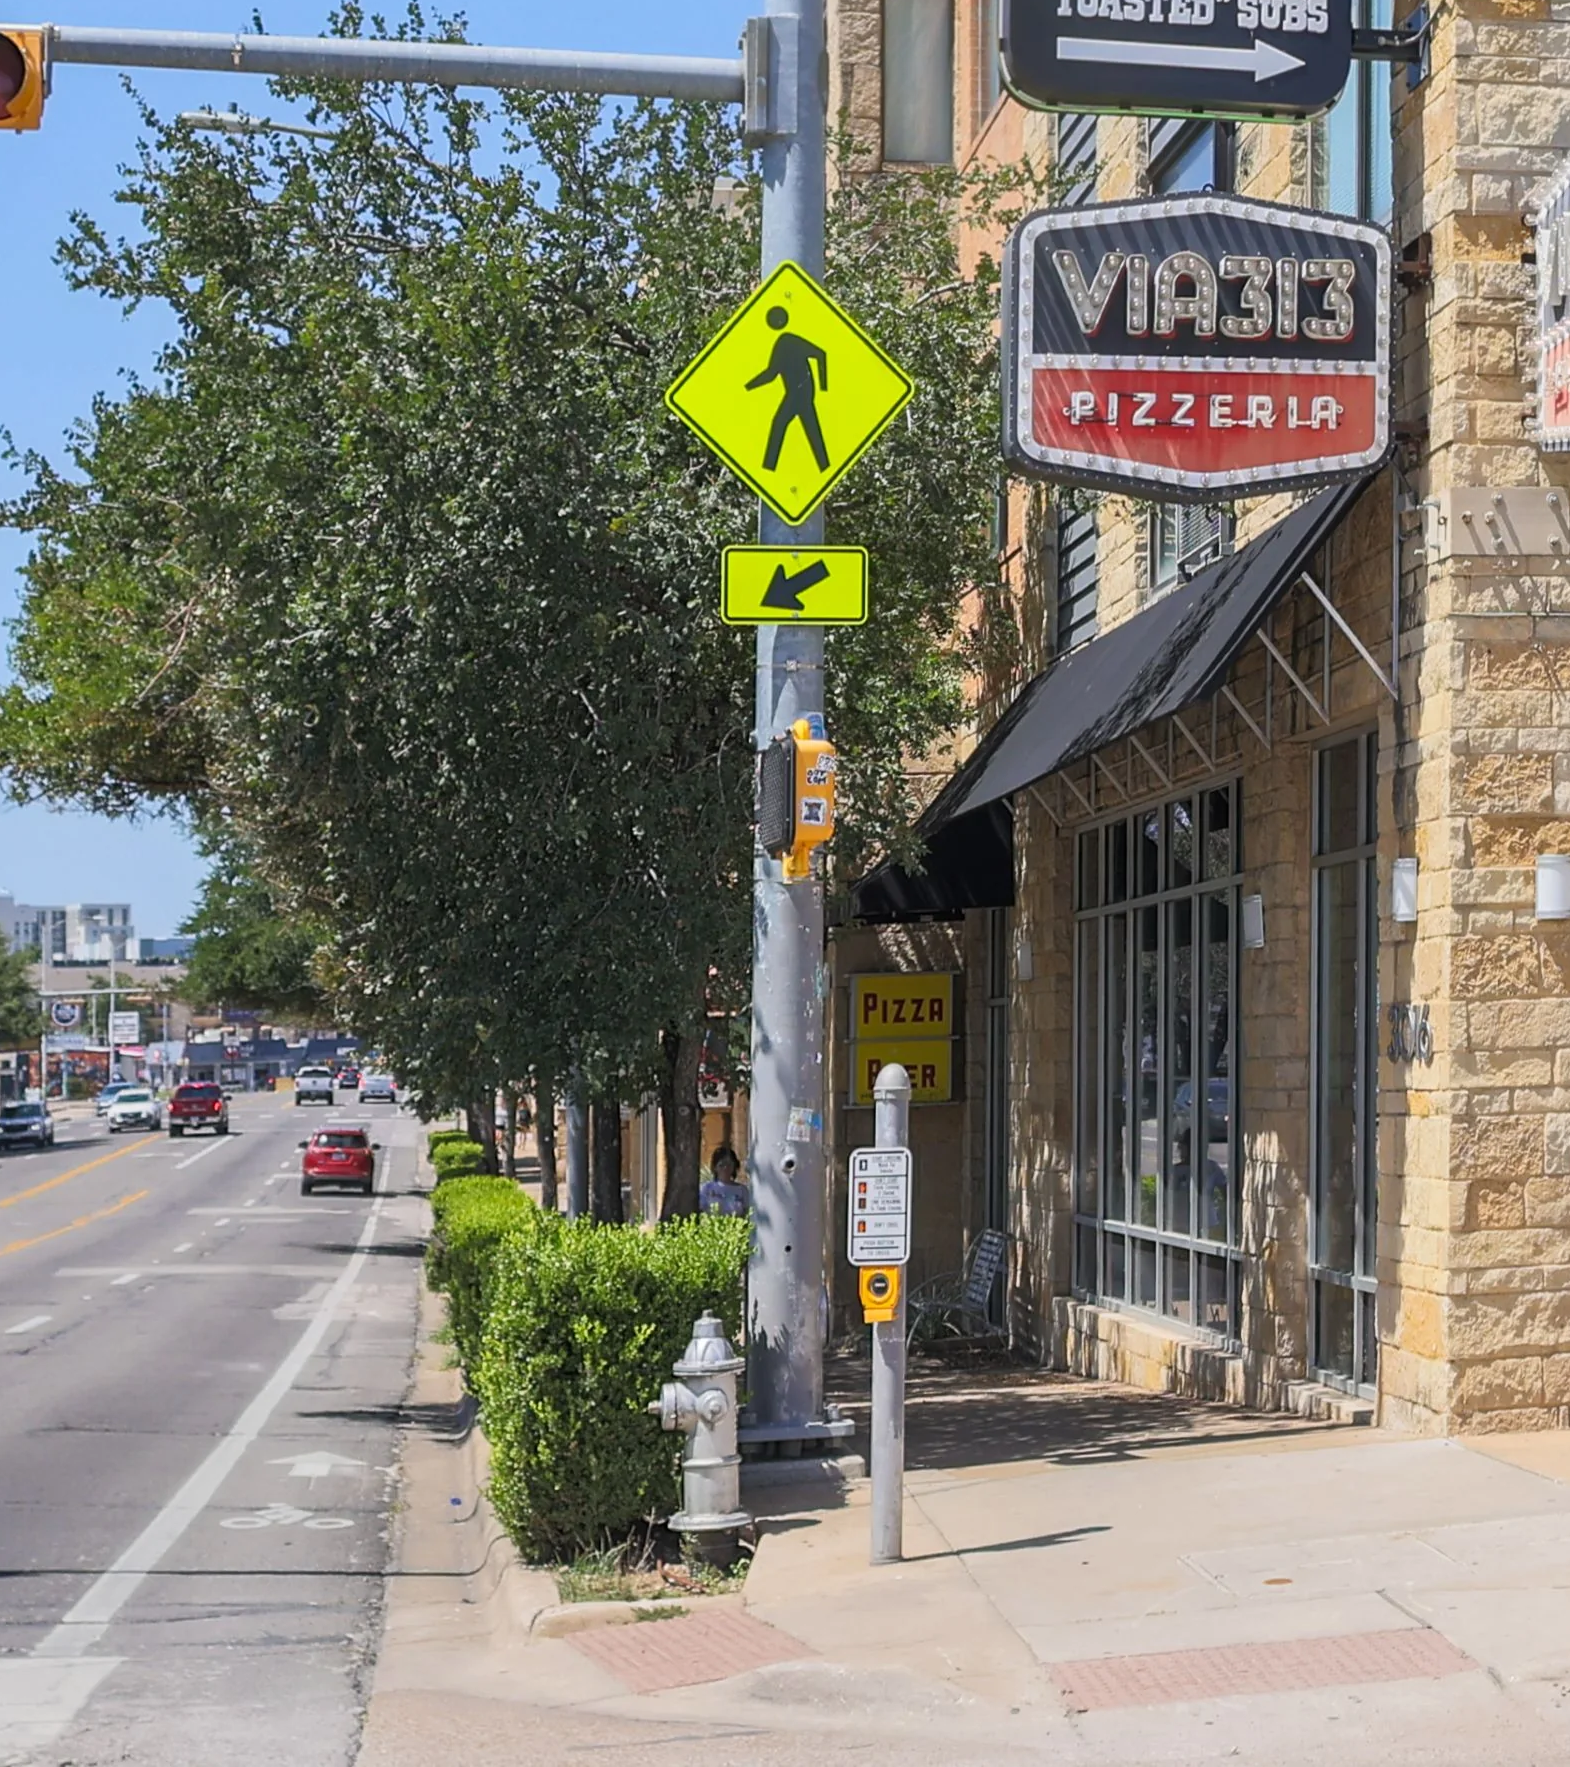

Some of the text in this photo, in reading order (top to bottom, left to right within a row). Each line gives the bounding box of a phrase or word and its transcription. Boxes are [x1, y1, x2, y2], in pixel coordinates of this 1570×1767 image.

[1069, 390, 1341, 431] PIZZERIA
[863, 992, 944, 1025] PIZZA
[867, 1058, 937, 1091] BER
